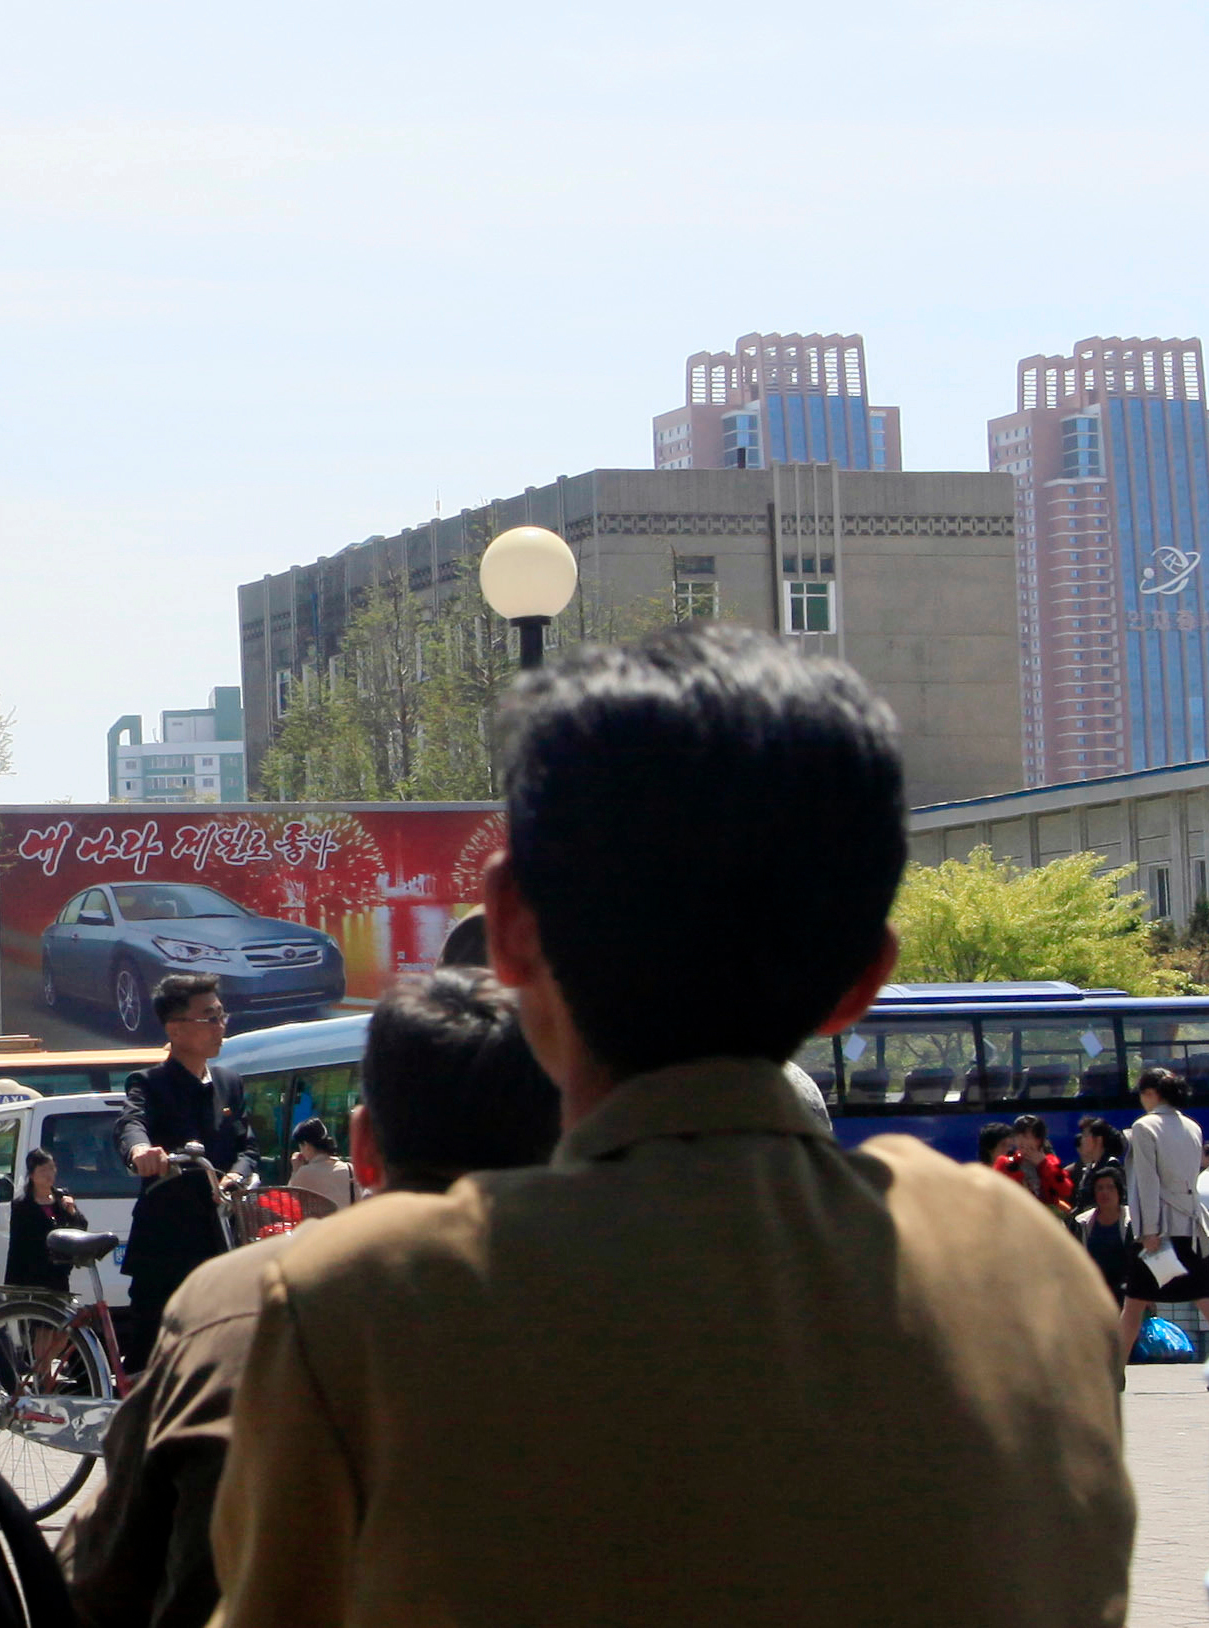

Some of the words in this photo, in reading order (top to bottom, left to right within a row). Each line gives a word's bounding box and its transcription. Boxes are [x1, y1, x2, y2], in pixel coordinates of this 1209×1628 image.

[19, 821, 72, 876] 내
[76, 821, 163, 874] 나라
[171, 821, 272, 871] 제일로
[274, 821, 339, 870] 좋아
